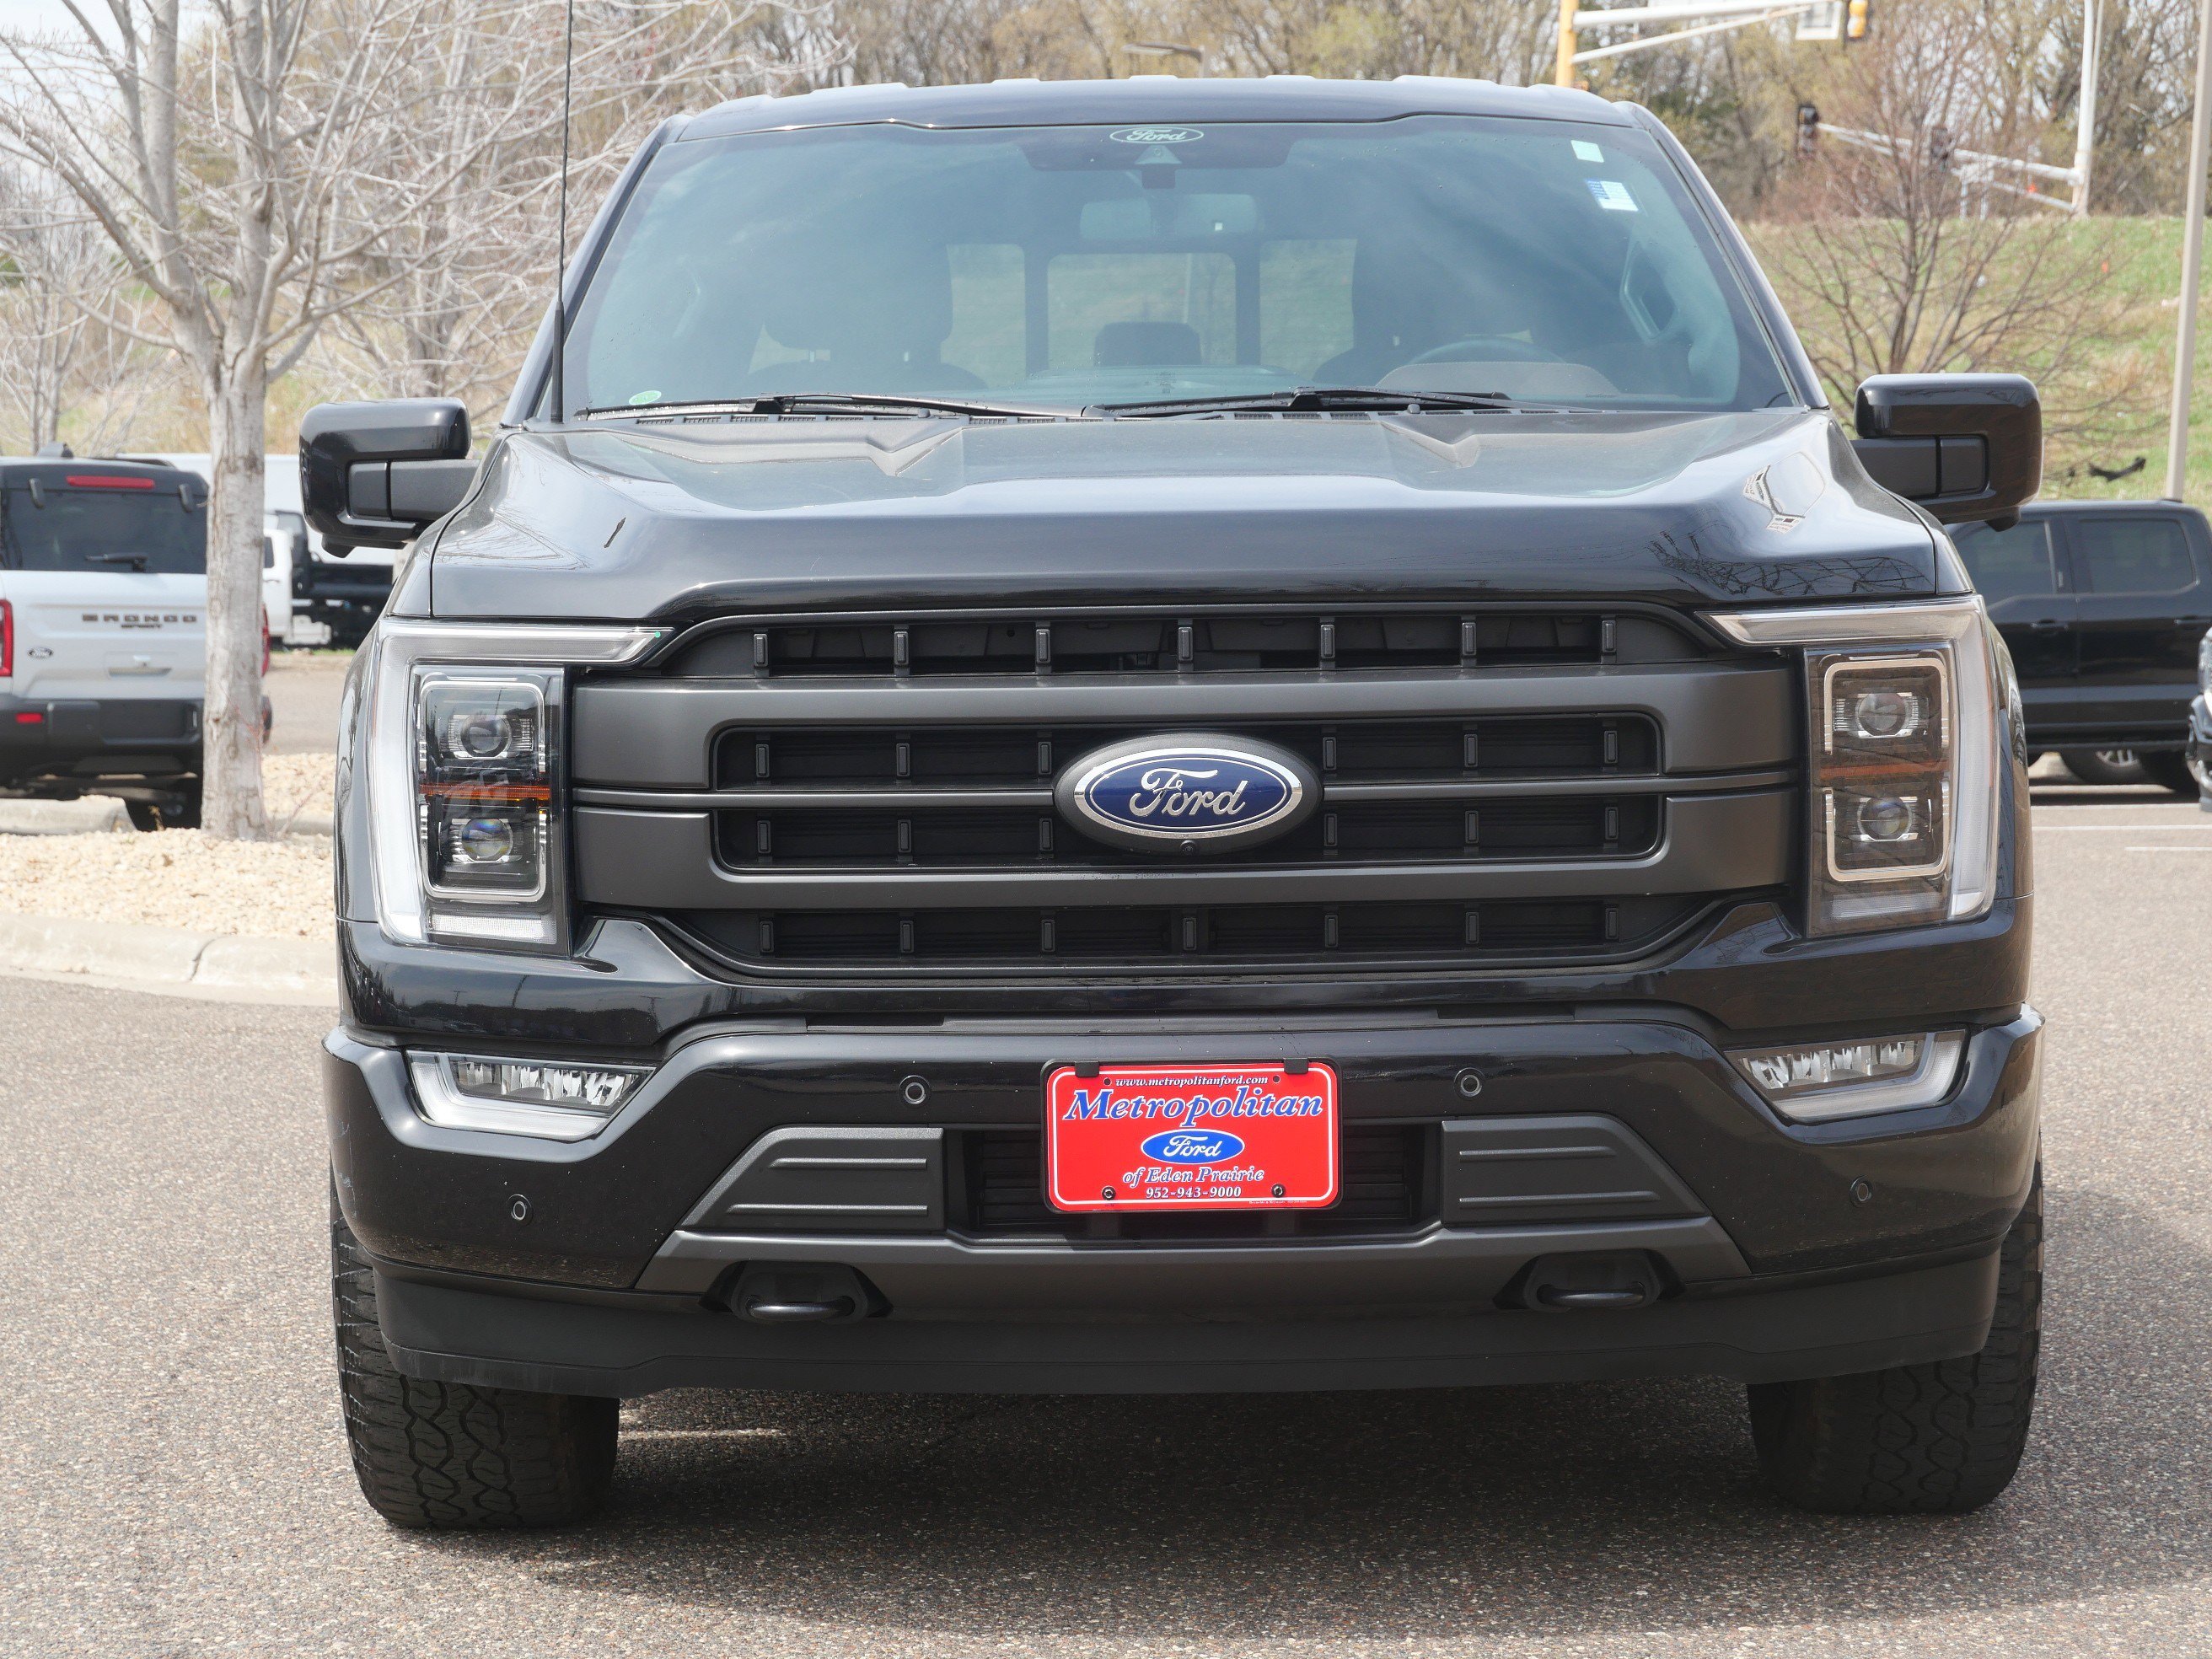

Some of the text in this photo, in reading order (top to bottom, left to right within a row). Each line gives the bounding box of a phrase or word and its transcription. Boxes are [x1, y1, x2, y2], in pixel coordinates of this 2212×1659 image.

[1126, 129, 1188, 141] Ford
[82, 614, 197, 623] BRONCO
[1130, 767, 1248, 817] Ford
[1115, 1075, 1269, 1088] www.metropolitanford.com
[1063, 1086, 1322, 1127] Metropolitan
[1163, 1134, 1222, 1158] Ford
[1123, 1165, 1264, 1189] of Eden Prairie
[1146, 1187, 1242, 1198] 952-943-9000
